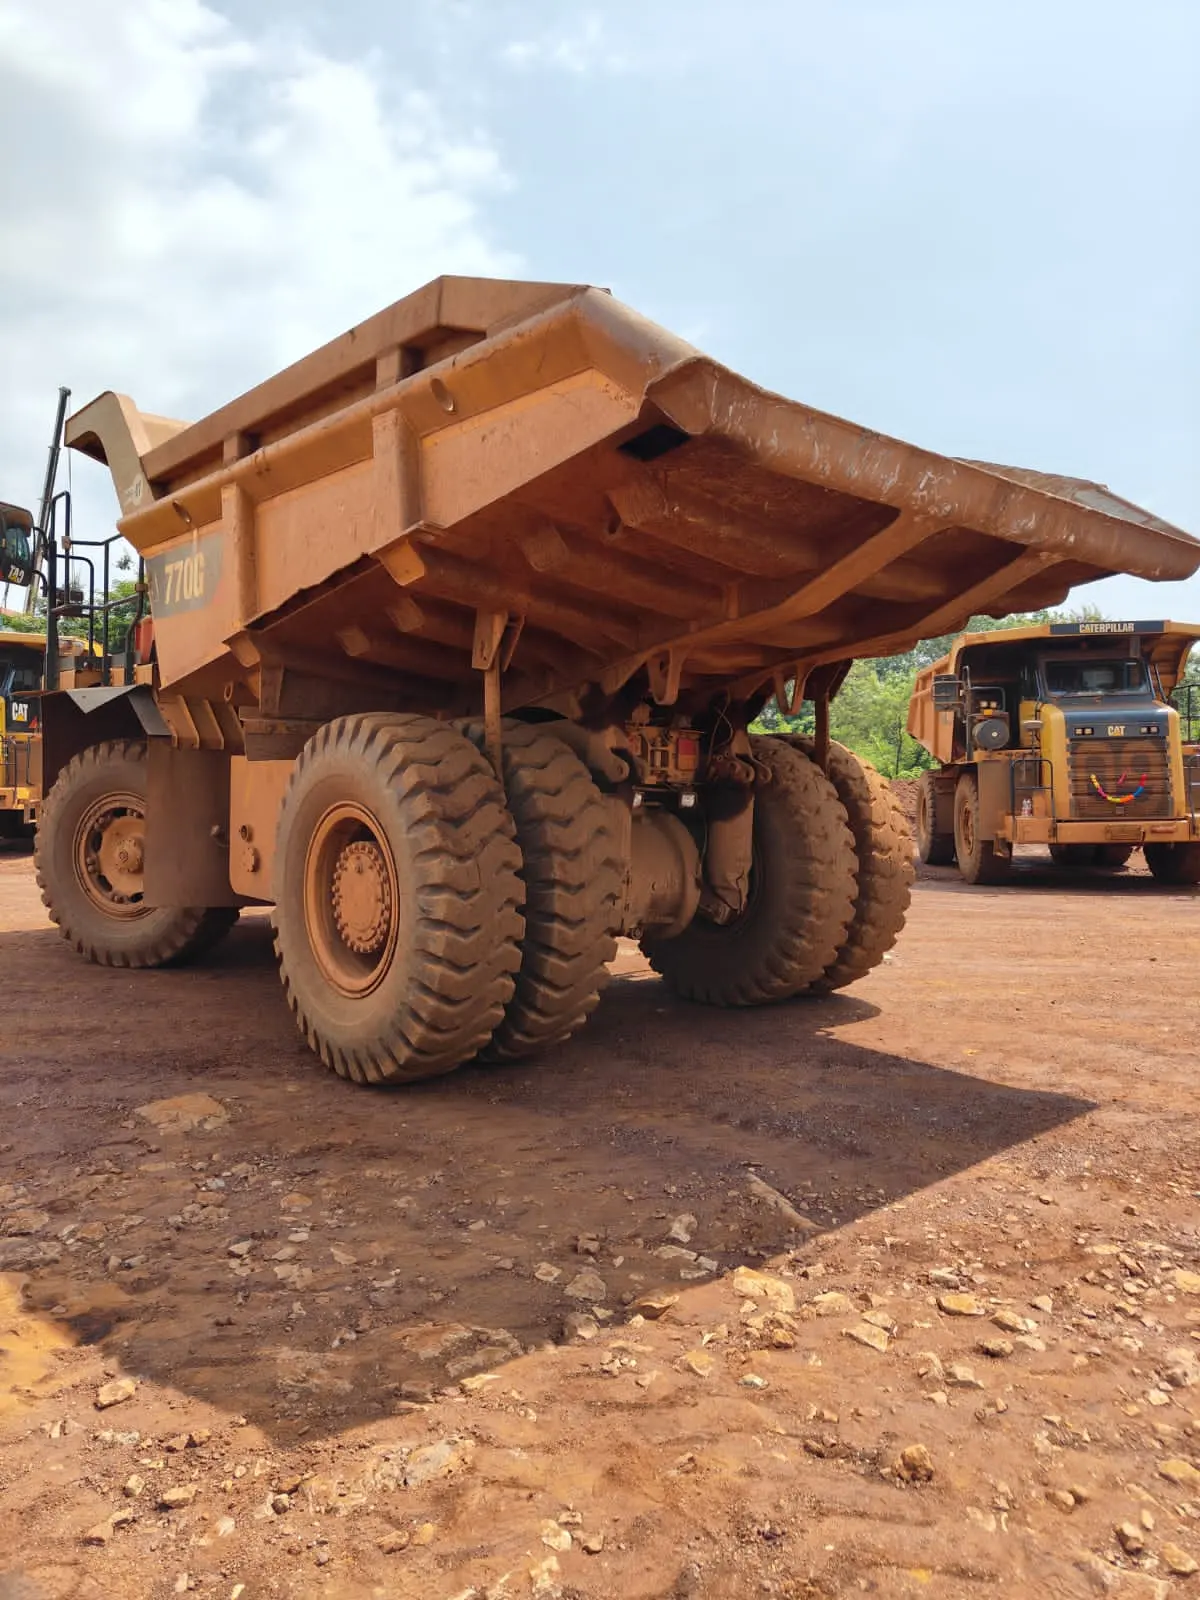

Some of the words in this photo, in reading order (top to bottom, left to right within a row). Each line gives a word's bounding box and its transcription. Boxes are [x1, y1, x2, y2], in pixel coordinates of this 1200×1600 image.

[164, 551, 205, 605] 770G
[1079, 622, 1135, 633] CATERPILLAR
[12, 702, 29, 721] CAT
[1107, 725, 1126, 737] CAT
